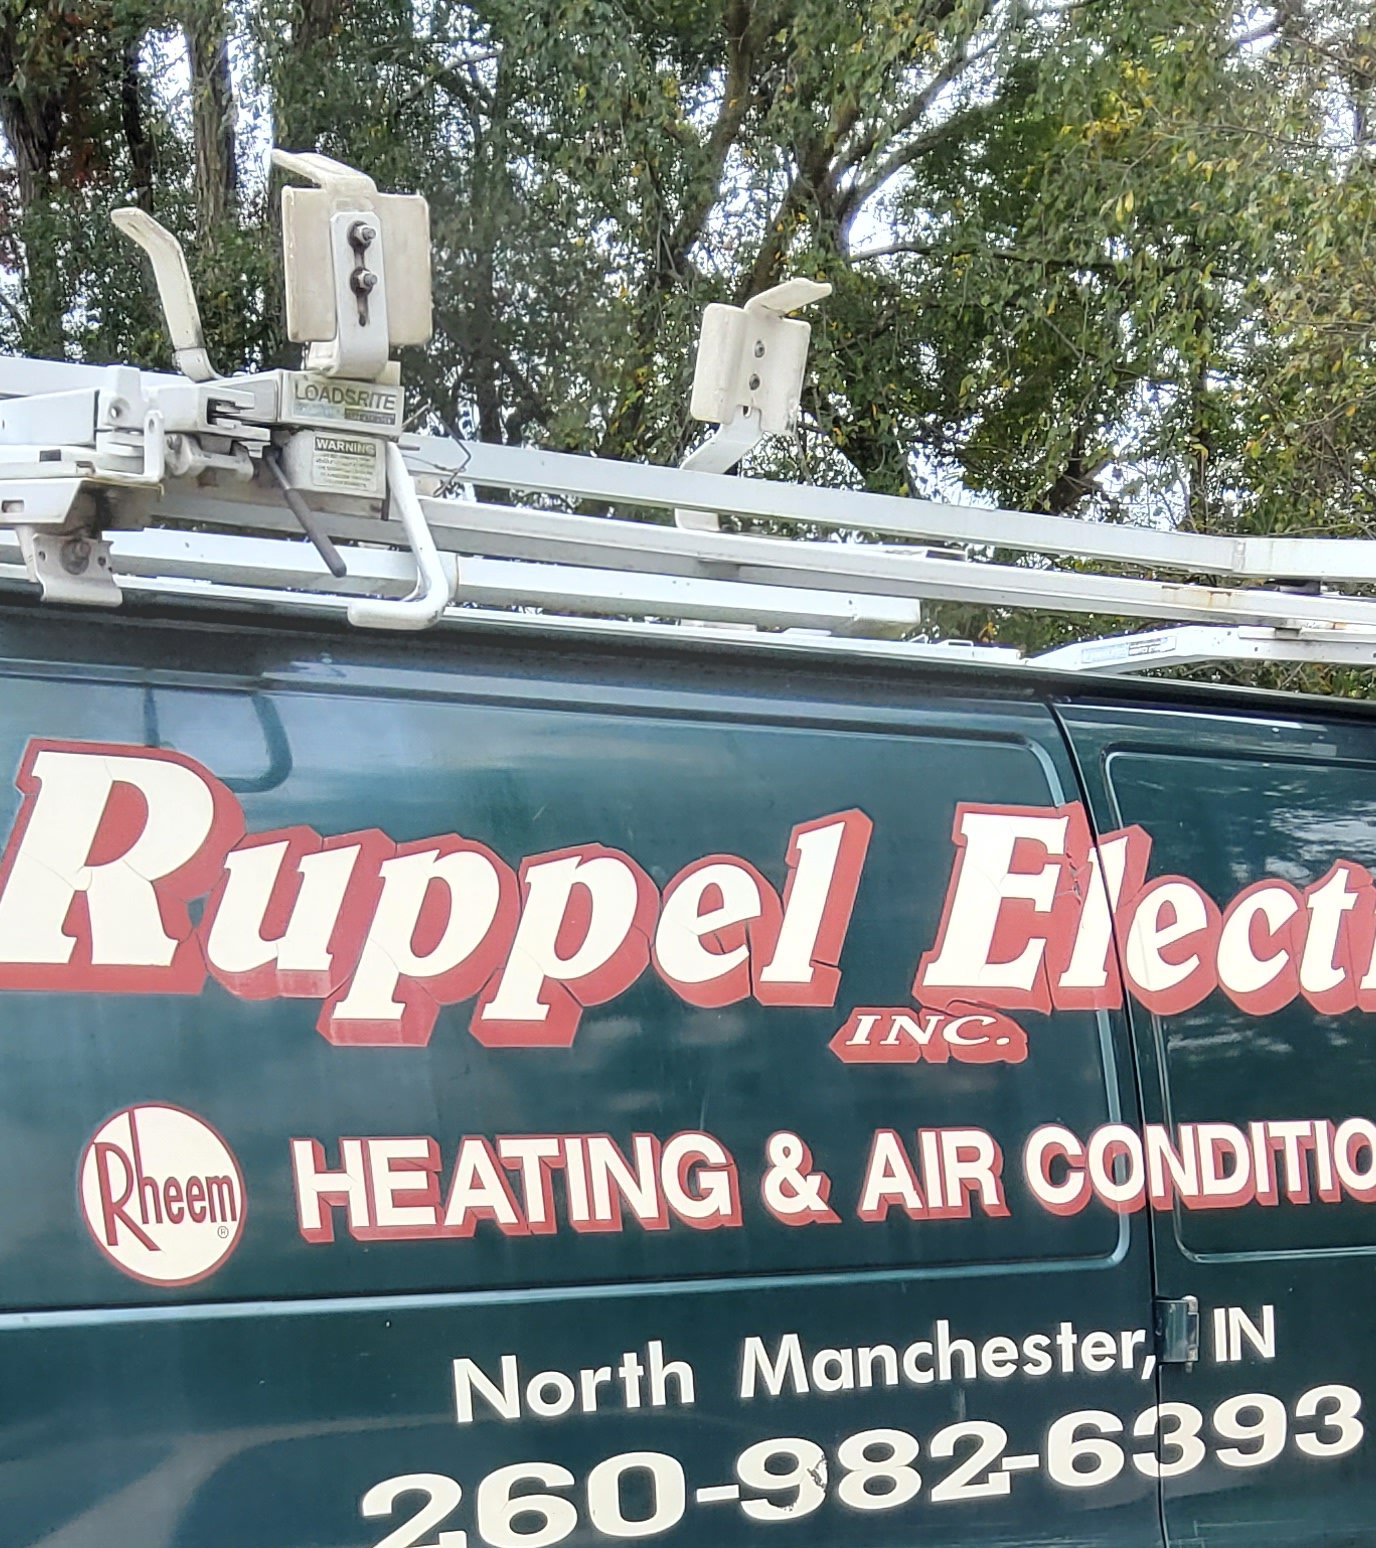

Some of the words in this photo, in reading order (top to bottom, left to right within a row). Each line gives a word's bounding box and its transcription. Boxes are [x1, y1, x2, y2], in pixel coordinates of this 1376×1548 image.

[294, 379, 398, 411] LOADSRITE
[315, 437, 376, 455] WARNING
[837, 1009, 1019, 1055] INC.
[92, 1110, 238, 1252] Rheem
[291, 1132, 738, 1238] HEATING
[762, 1131, 838, 1220] &
[858, 1128, 1008, 1219] AIR
[453, 1340, 695, 1424] North
[740, 1319, 1158, 1398] Manchester,
[1213, 1304, 1276, 1363] IN
